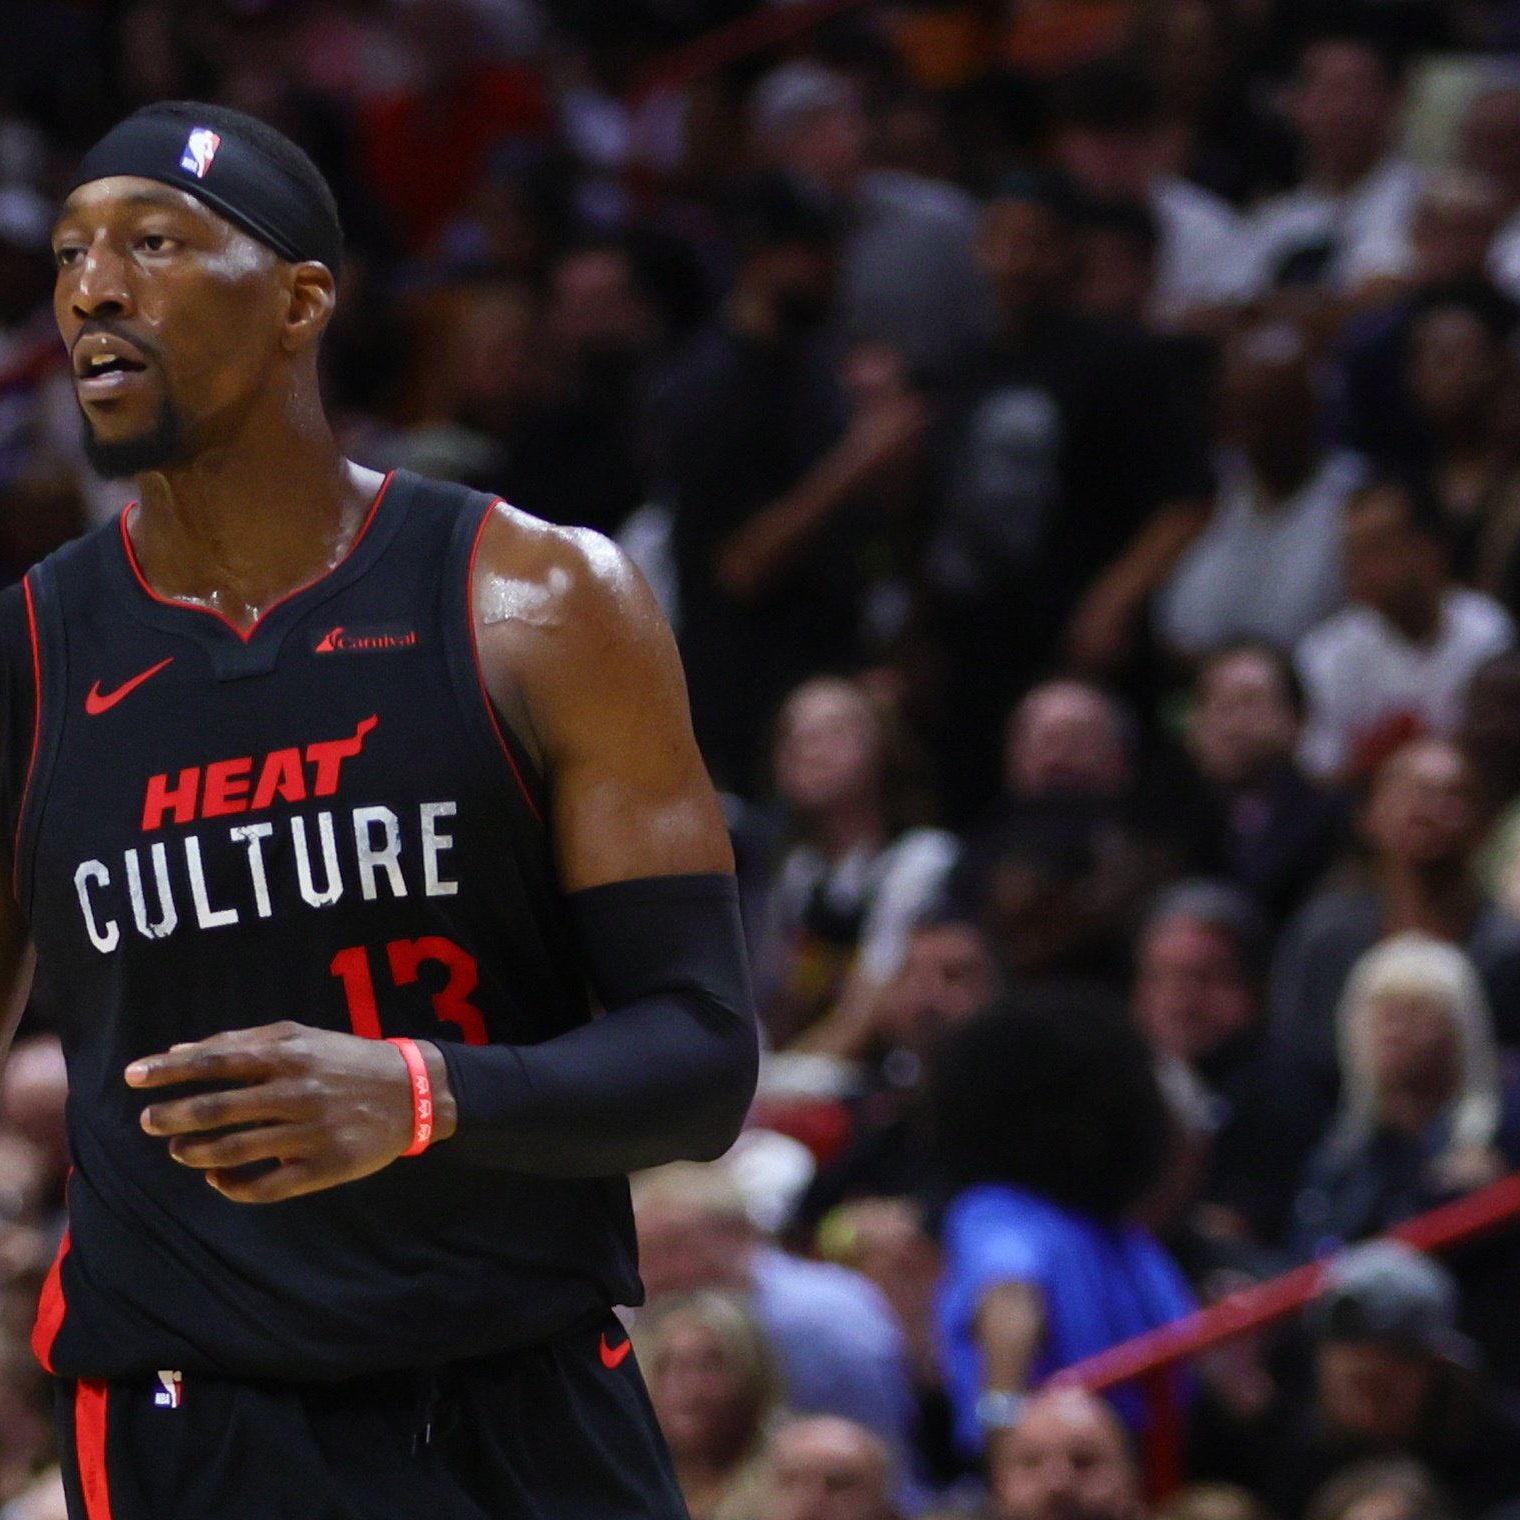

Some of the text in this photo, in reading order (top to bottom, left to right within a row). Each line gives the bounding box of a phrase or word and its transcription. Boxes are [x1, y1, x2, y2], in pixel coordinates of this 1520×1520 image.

[141, 714, 378, 832] HEAT
[74, 801, 459, 954] CULTURE
[330, 936, 488, 1047] 13
